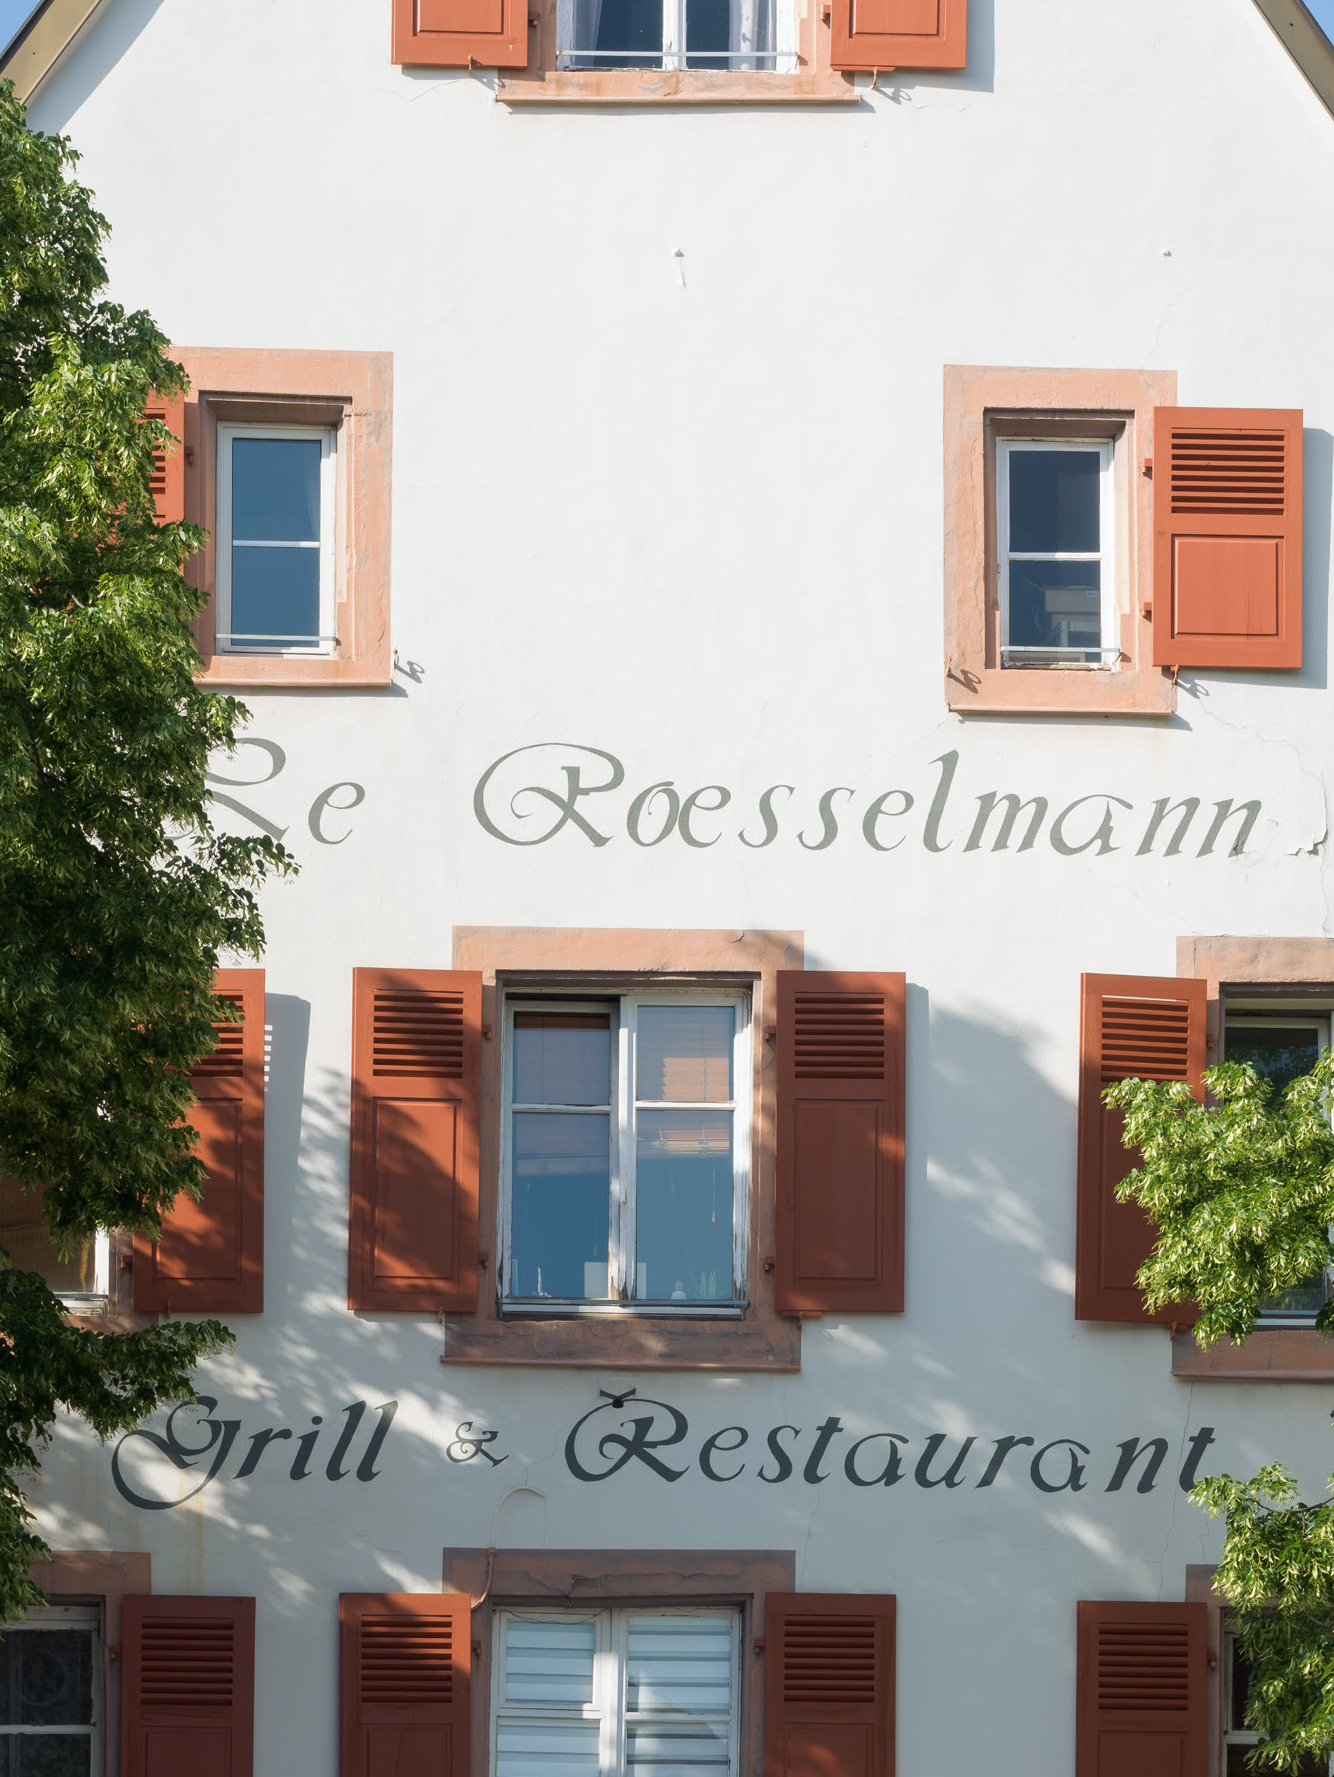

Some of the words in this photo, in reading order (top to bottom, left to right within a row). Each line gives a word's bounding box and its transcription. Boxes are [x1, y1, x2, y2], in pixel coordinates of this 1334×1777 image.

[473, 742, 1262, 859] Roesselmann
[110, 1396, 392, 1512] Grill
[446, 1420, 510, 1468] &
[564, 1396, 1217, 1495] Restaurant
